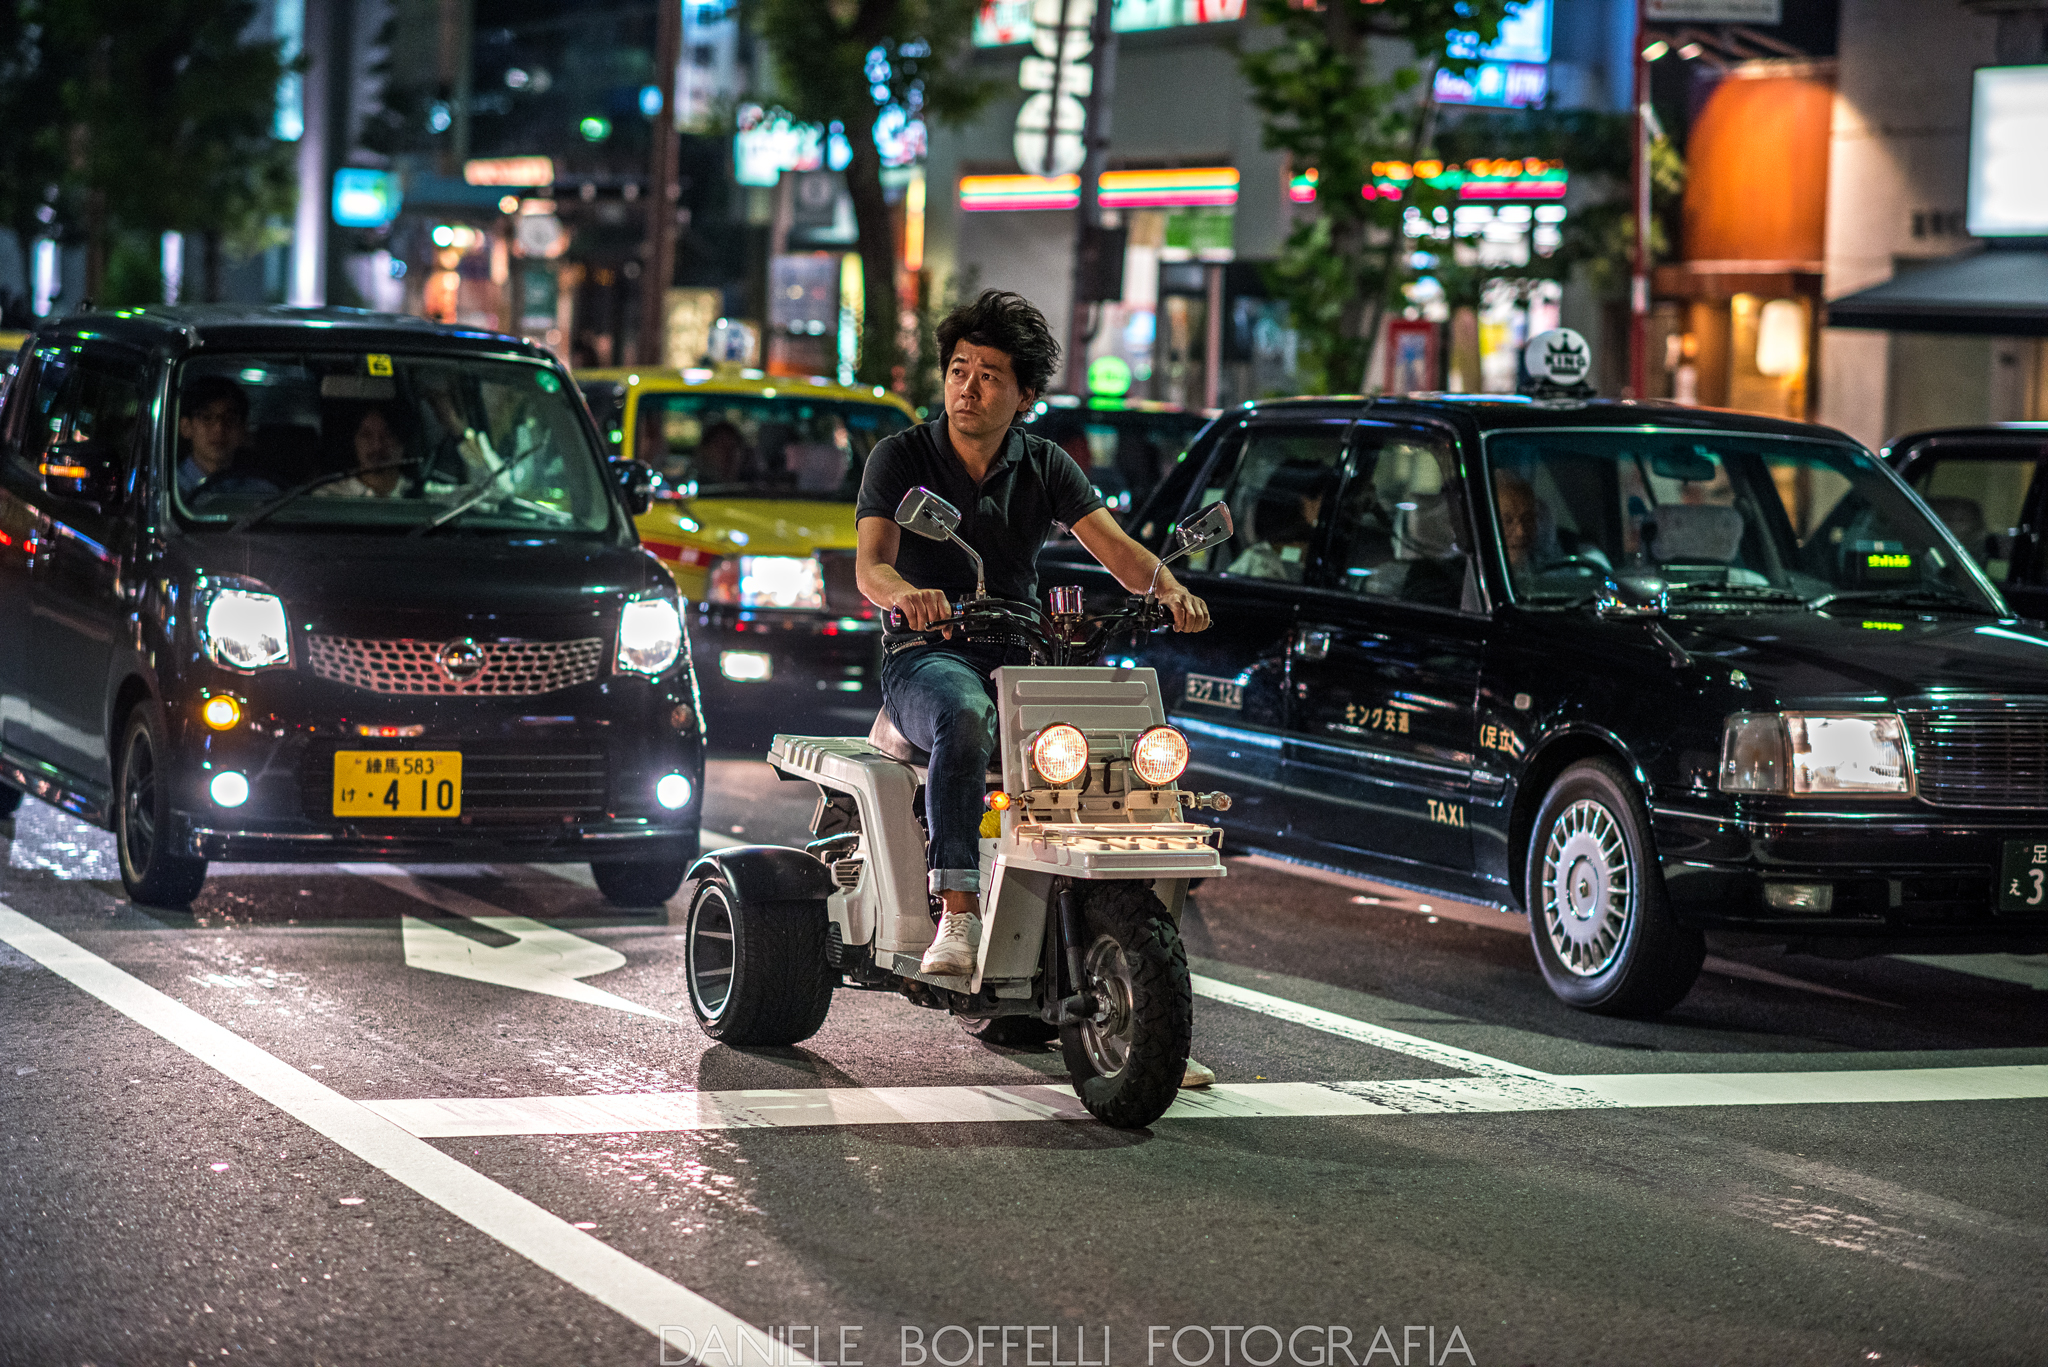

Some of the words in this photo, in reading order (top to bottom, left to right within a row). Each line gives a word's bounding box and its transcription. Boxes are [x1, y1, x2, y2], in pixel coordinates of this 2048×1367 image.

[1545, 355, 1586, 367] KING
[341, 788, 356, 802] け
[1427, 799, 1465, 828] TAXI
[2009, 878, 2021, 896] え
[2026, 868, 2044, 905] 3
